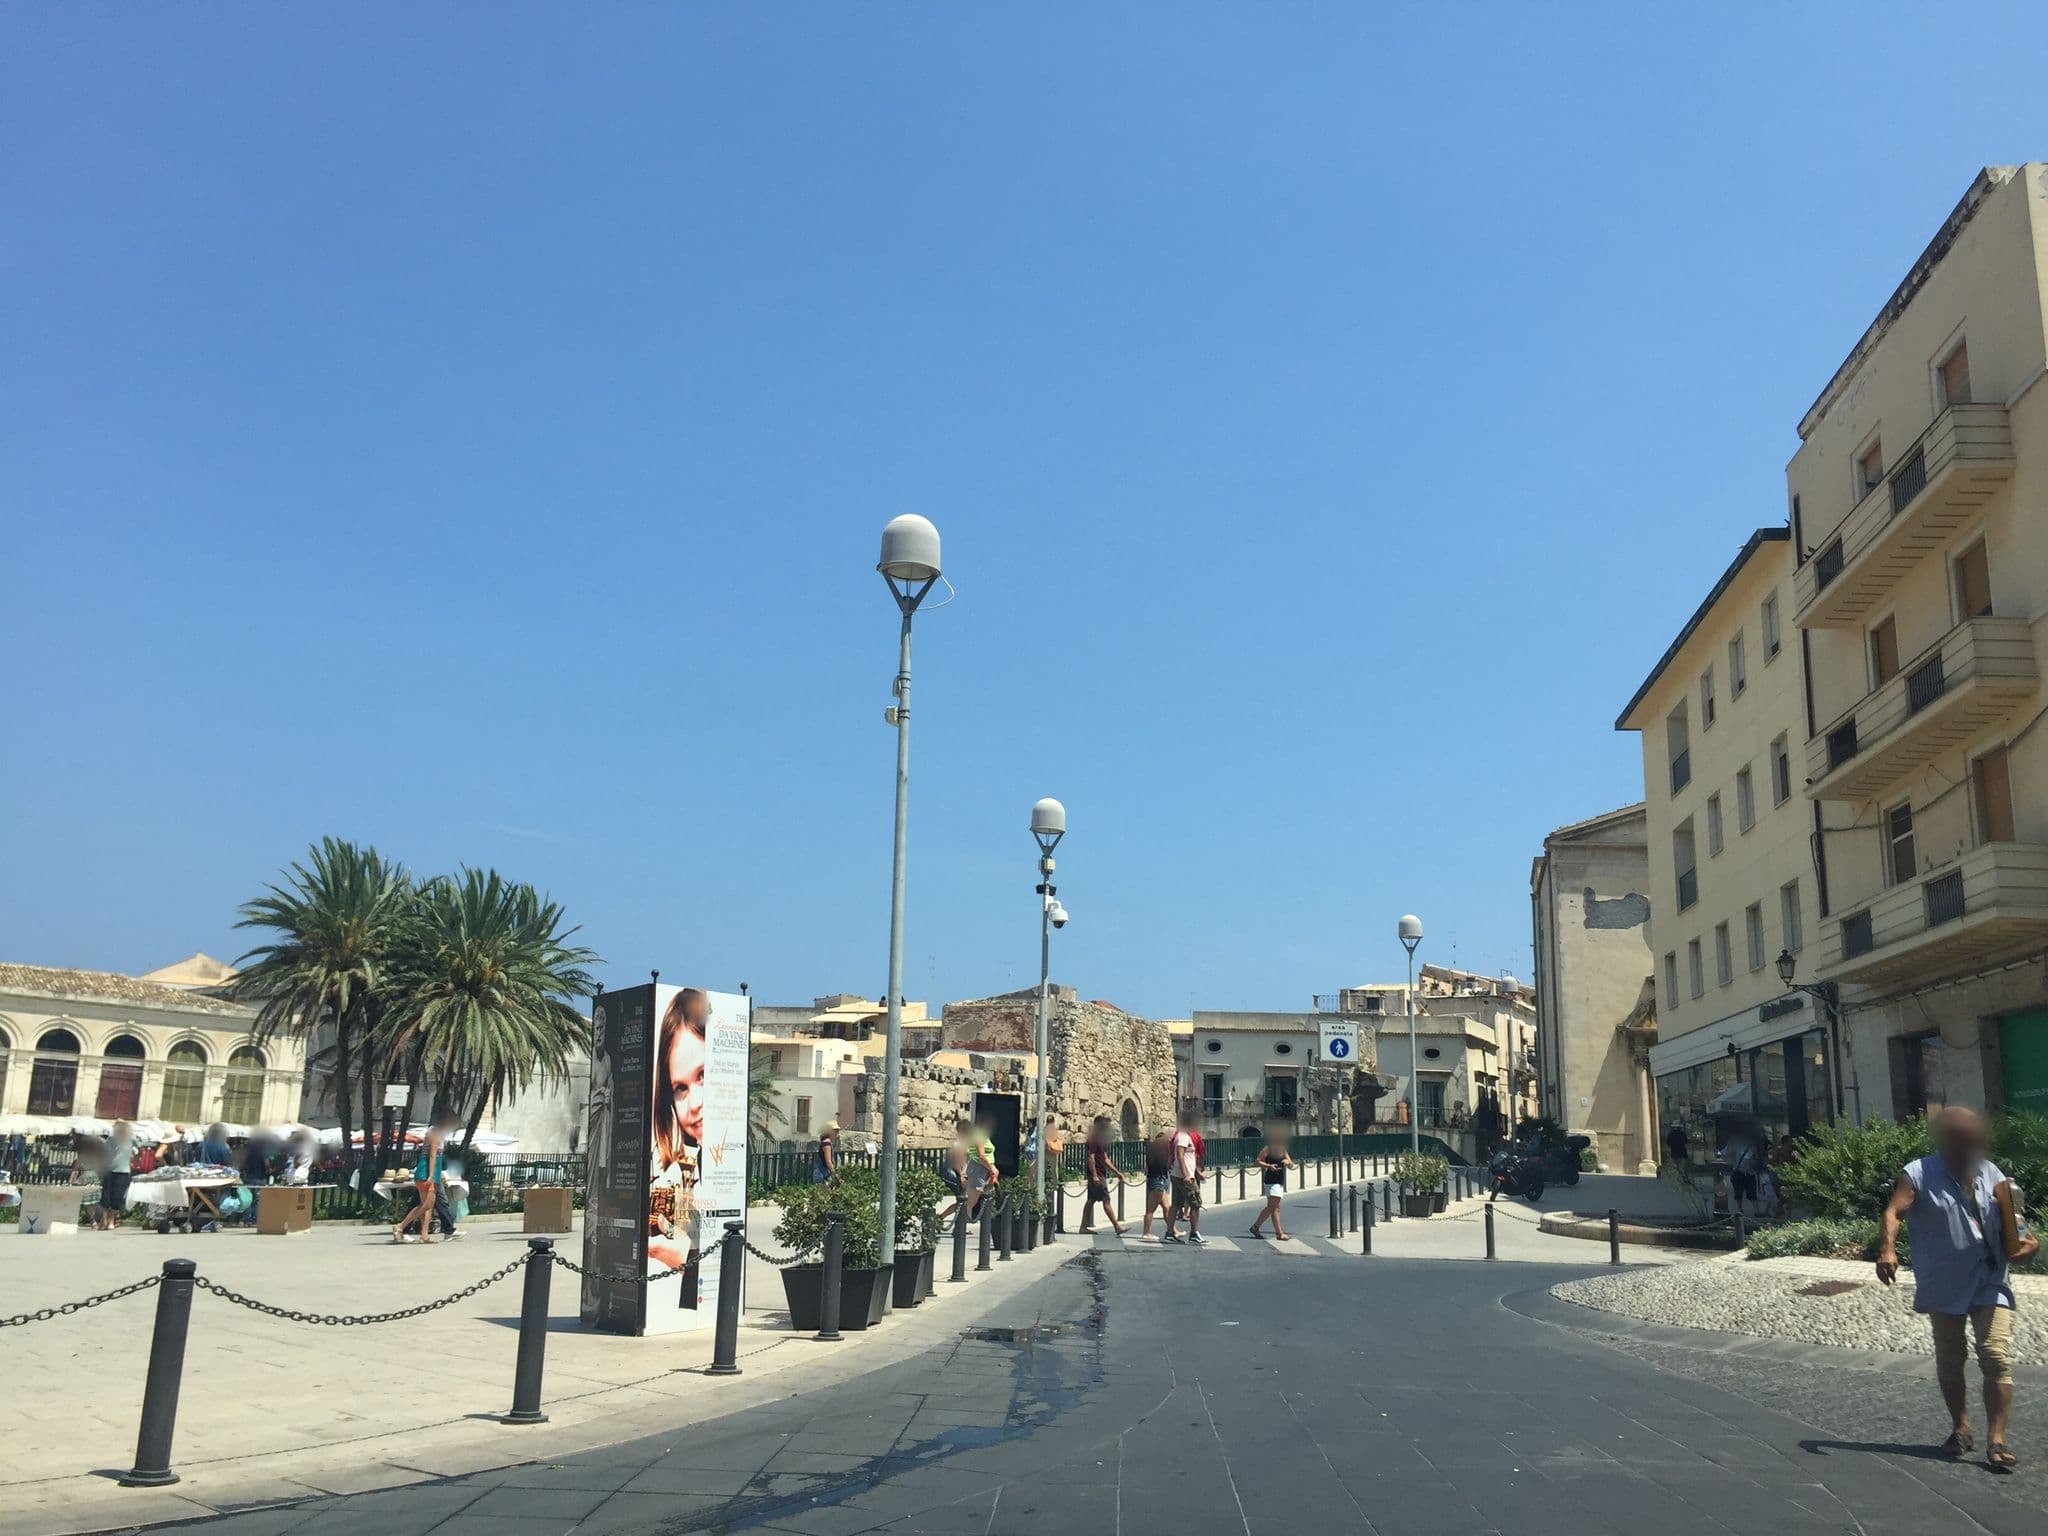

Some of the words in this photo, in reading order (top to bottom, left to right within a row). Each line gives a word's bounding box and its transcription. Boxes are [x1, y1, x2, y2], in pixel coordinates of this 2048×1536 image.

[719, 1029, 729, 1039] DA
[729, 1030, 748, 1041] VINCI
[713, 1038, 748, 1050] MACHINES
